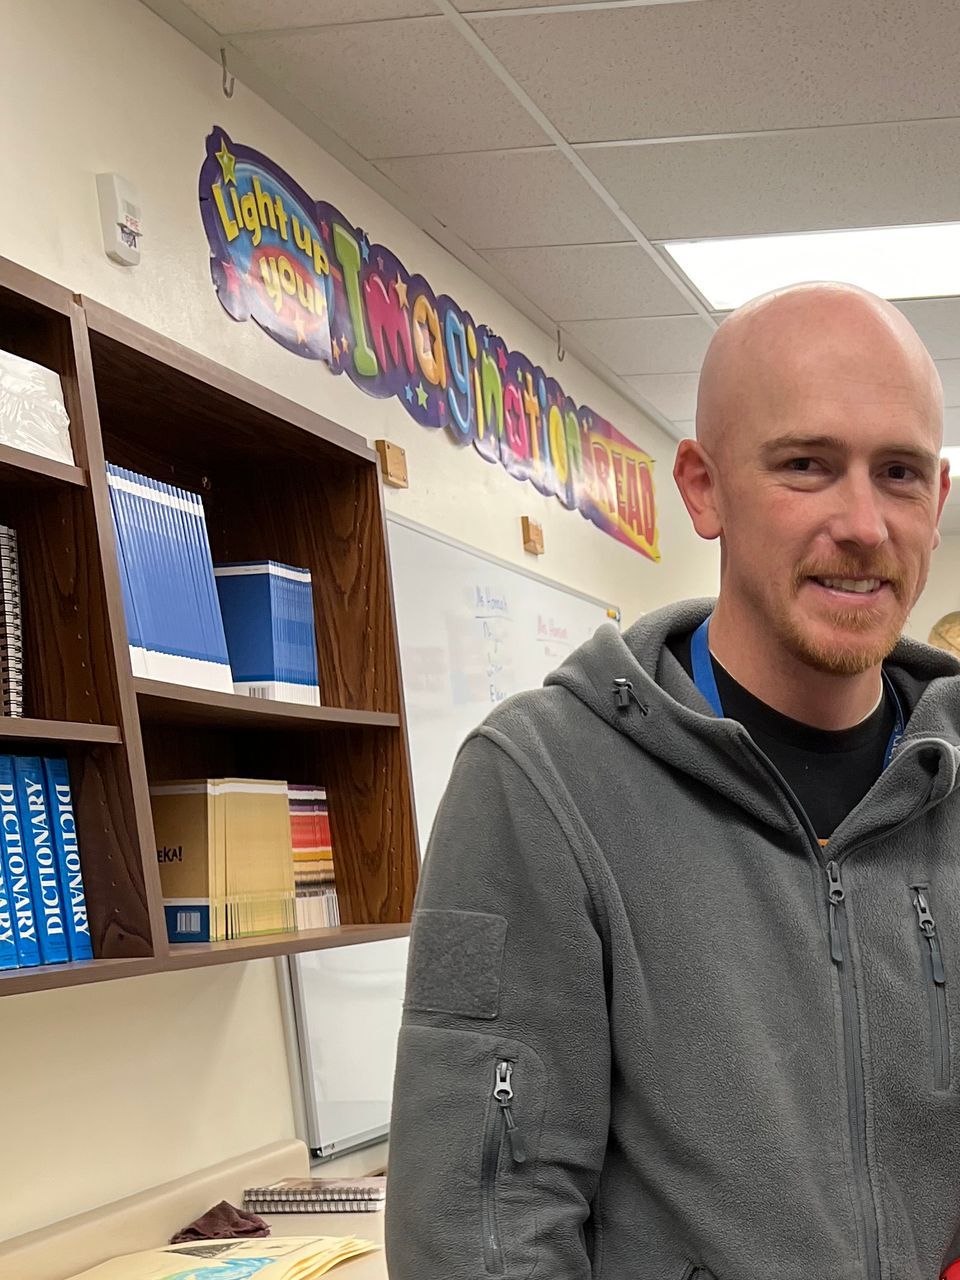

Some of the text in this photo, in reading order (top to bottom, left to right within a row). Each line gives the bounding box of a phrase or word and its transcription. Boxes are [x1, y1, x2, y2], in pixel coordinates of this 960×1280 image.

[212, 175, 330, 275] Light up
[259, 255, 328, 317] your
[332, 222, 586, 508] Imagination
[590, 440, 656, 548] READ
[0, 784, 37, 944] DICTIONARY
[25, 777, 64, 936] DICTIONARY
[55, 784, 90, 937] DICTIONARY
